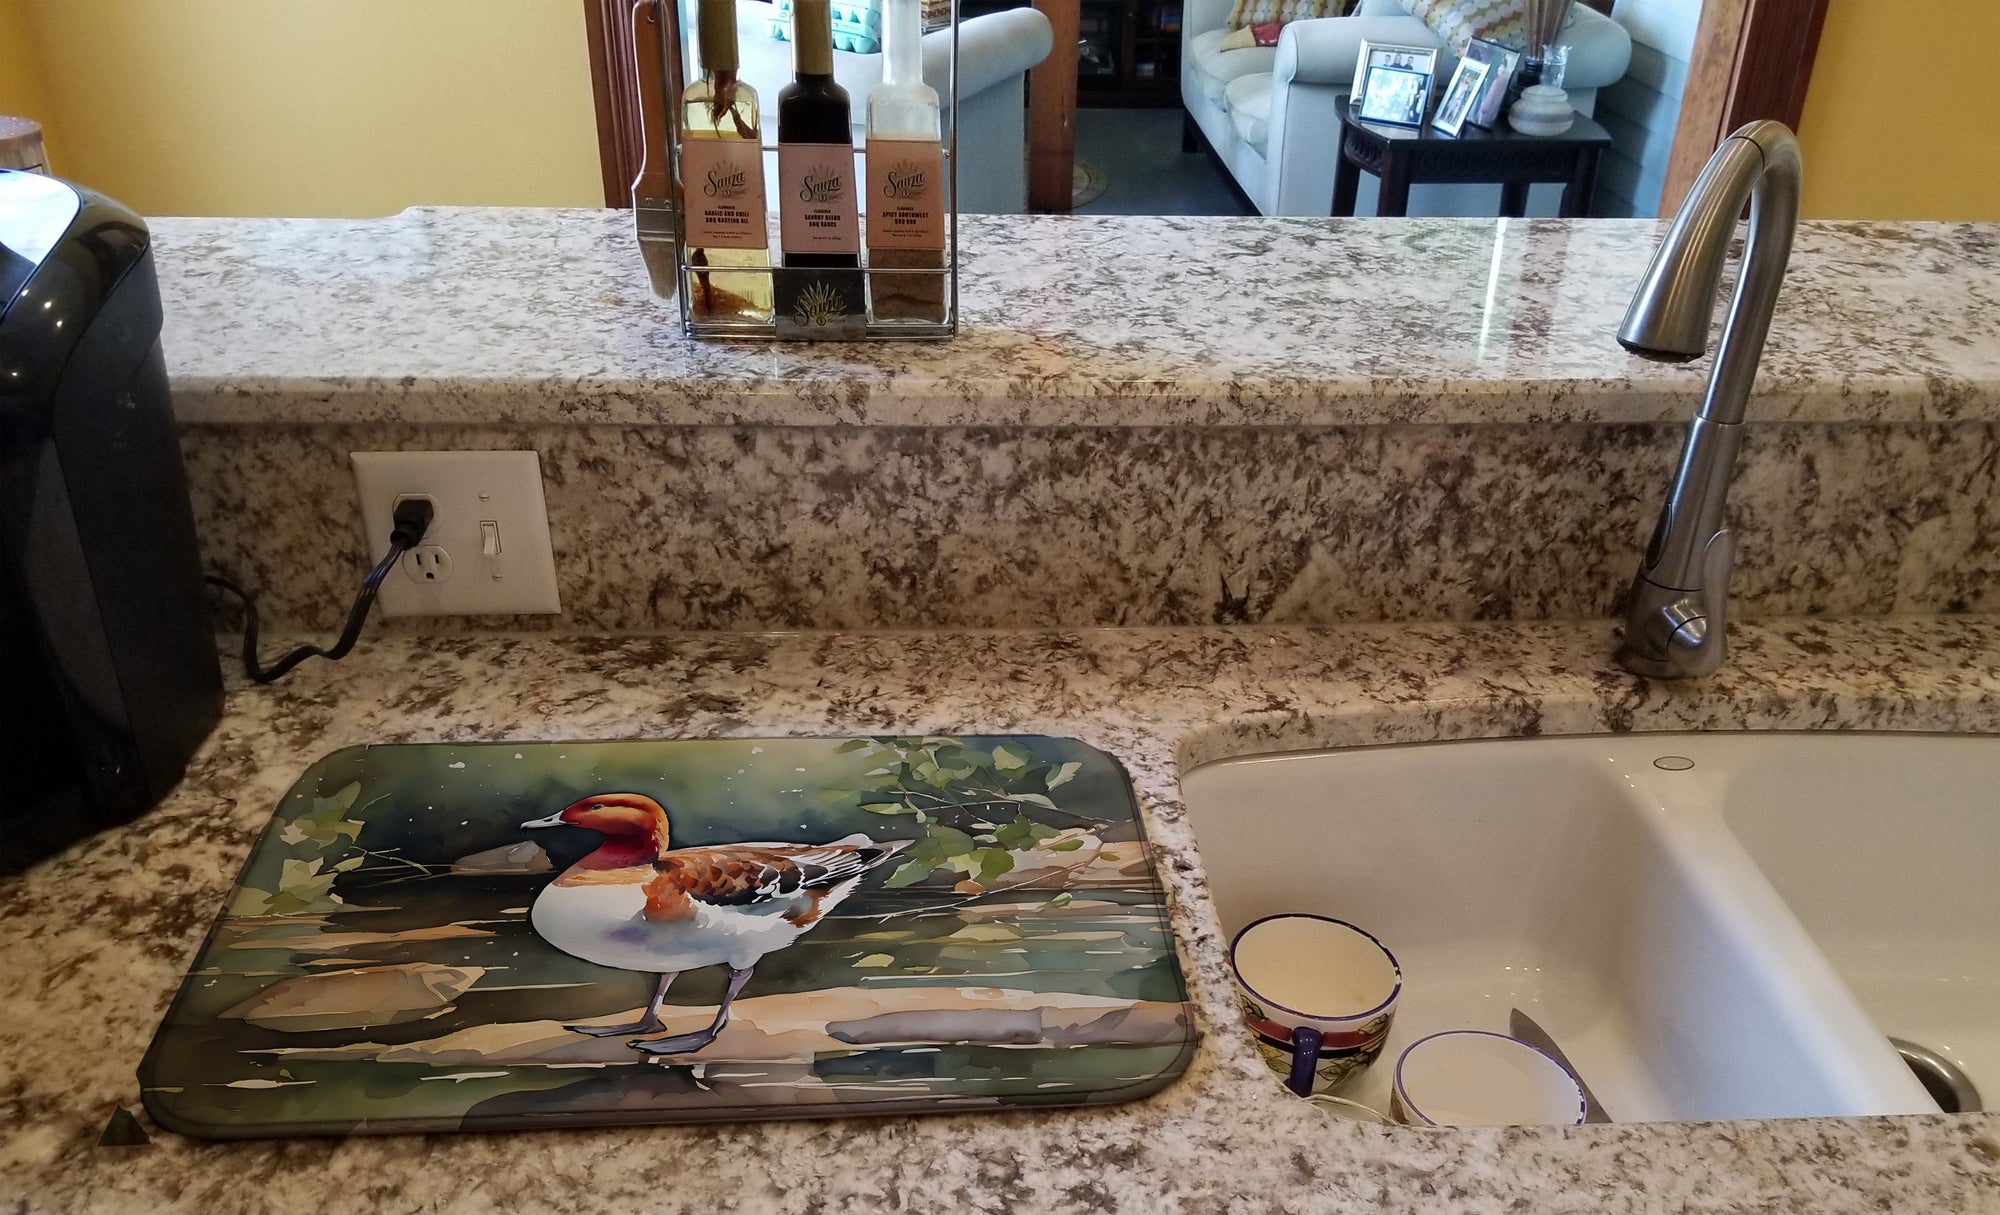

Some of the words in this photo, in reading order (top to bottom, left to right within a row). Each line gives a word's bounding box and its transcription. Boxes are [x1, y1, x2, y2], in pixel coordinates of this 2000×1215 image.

[704, 170, 745, 197] Sauza
[800, 176, 840, 202] Sauza
[884, 171, 924, 198] Sauza
[793, 296, 846, 326] Sauza
